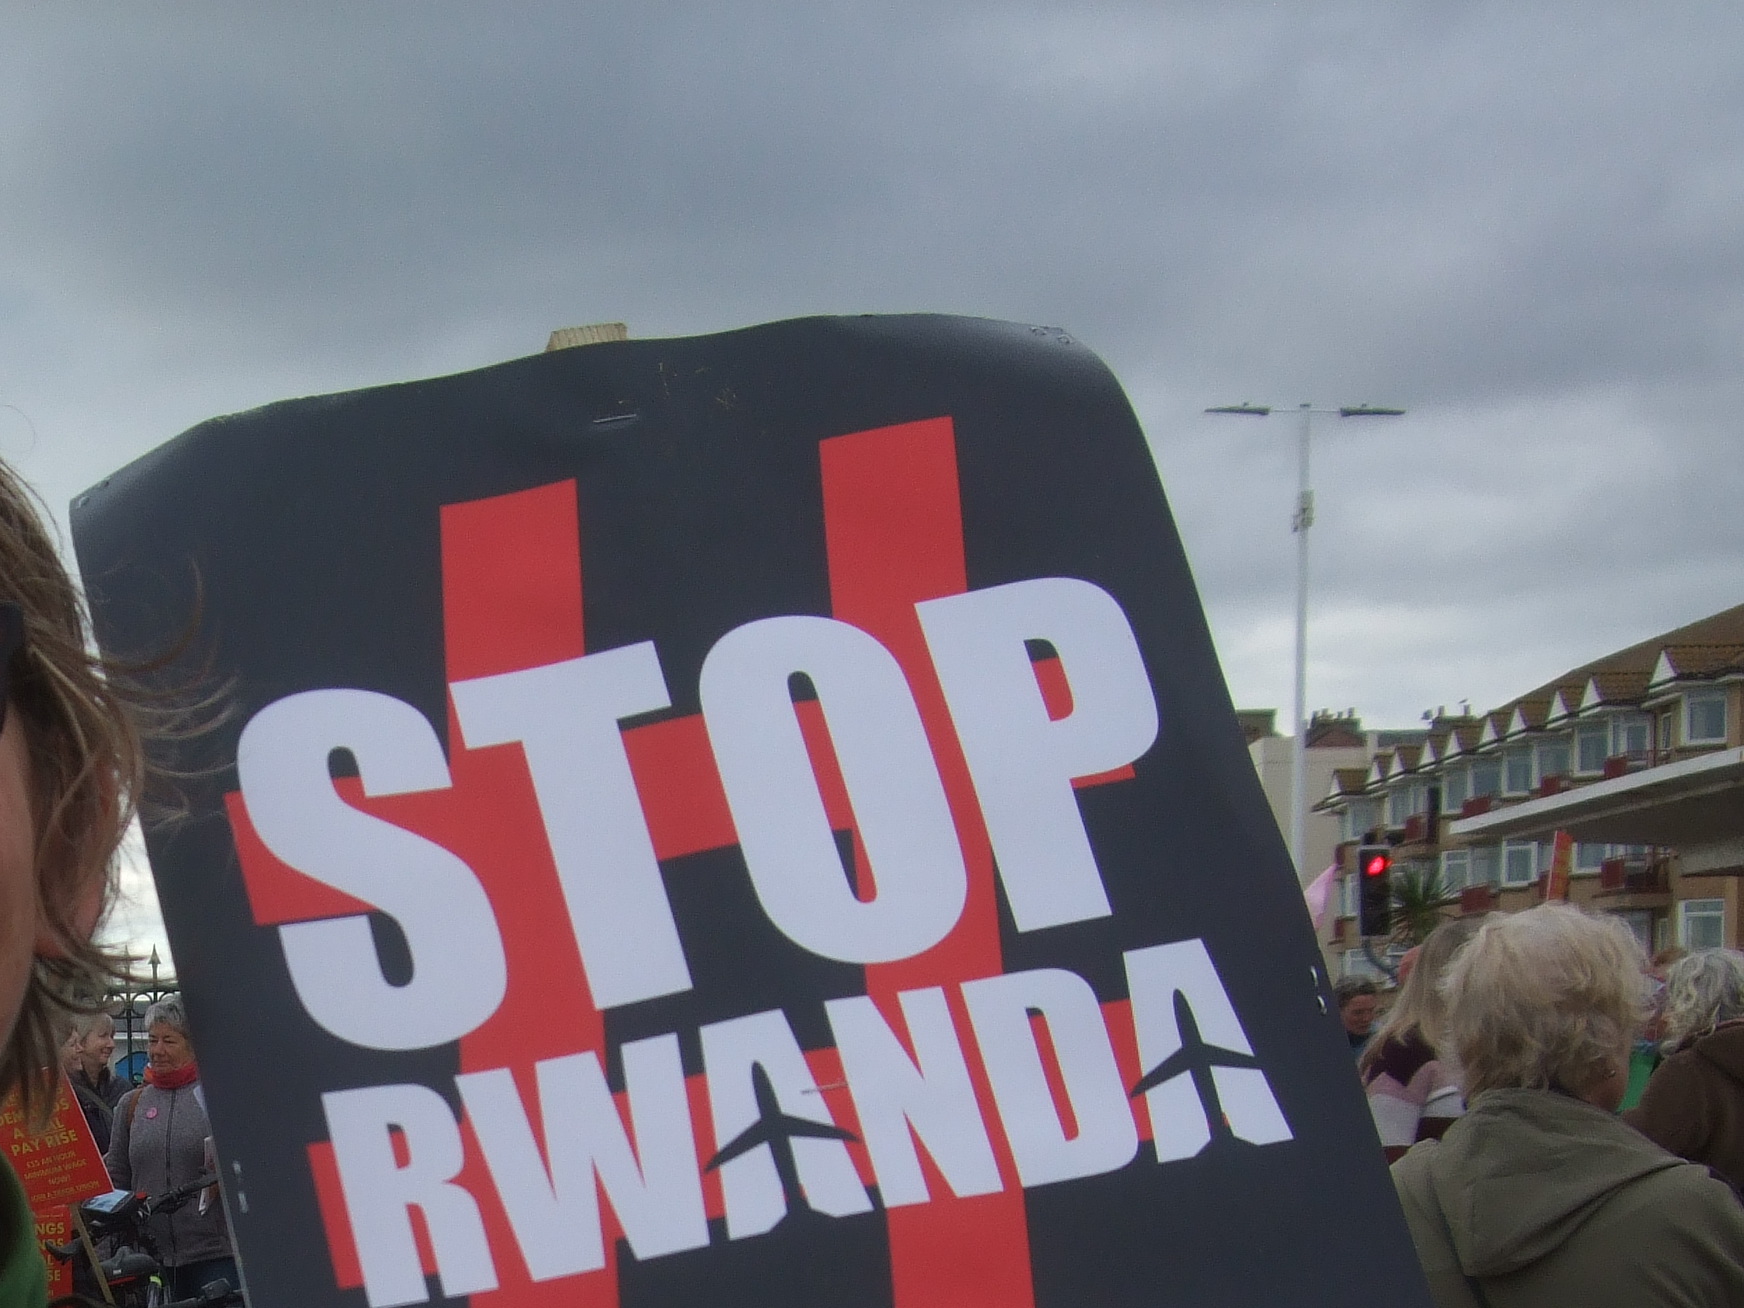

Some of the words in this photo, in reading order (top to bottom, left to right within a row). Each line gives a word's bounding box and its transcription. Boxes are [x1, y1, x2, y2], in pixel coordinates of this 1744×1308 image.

[236, 577, 1160, 1051] STOP
[11, 1139, 41, 1157] PAY
[45, 1129, 78, 1148] RISE
